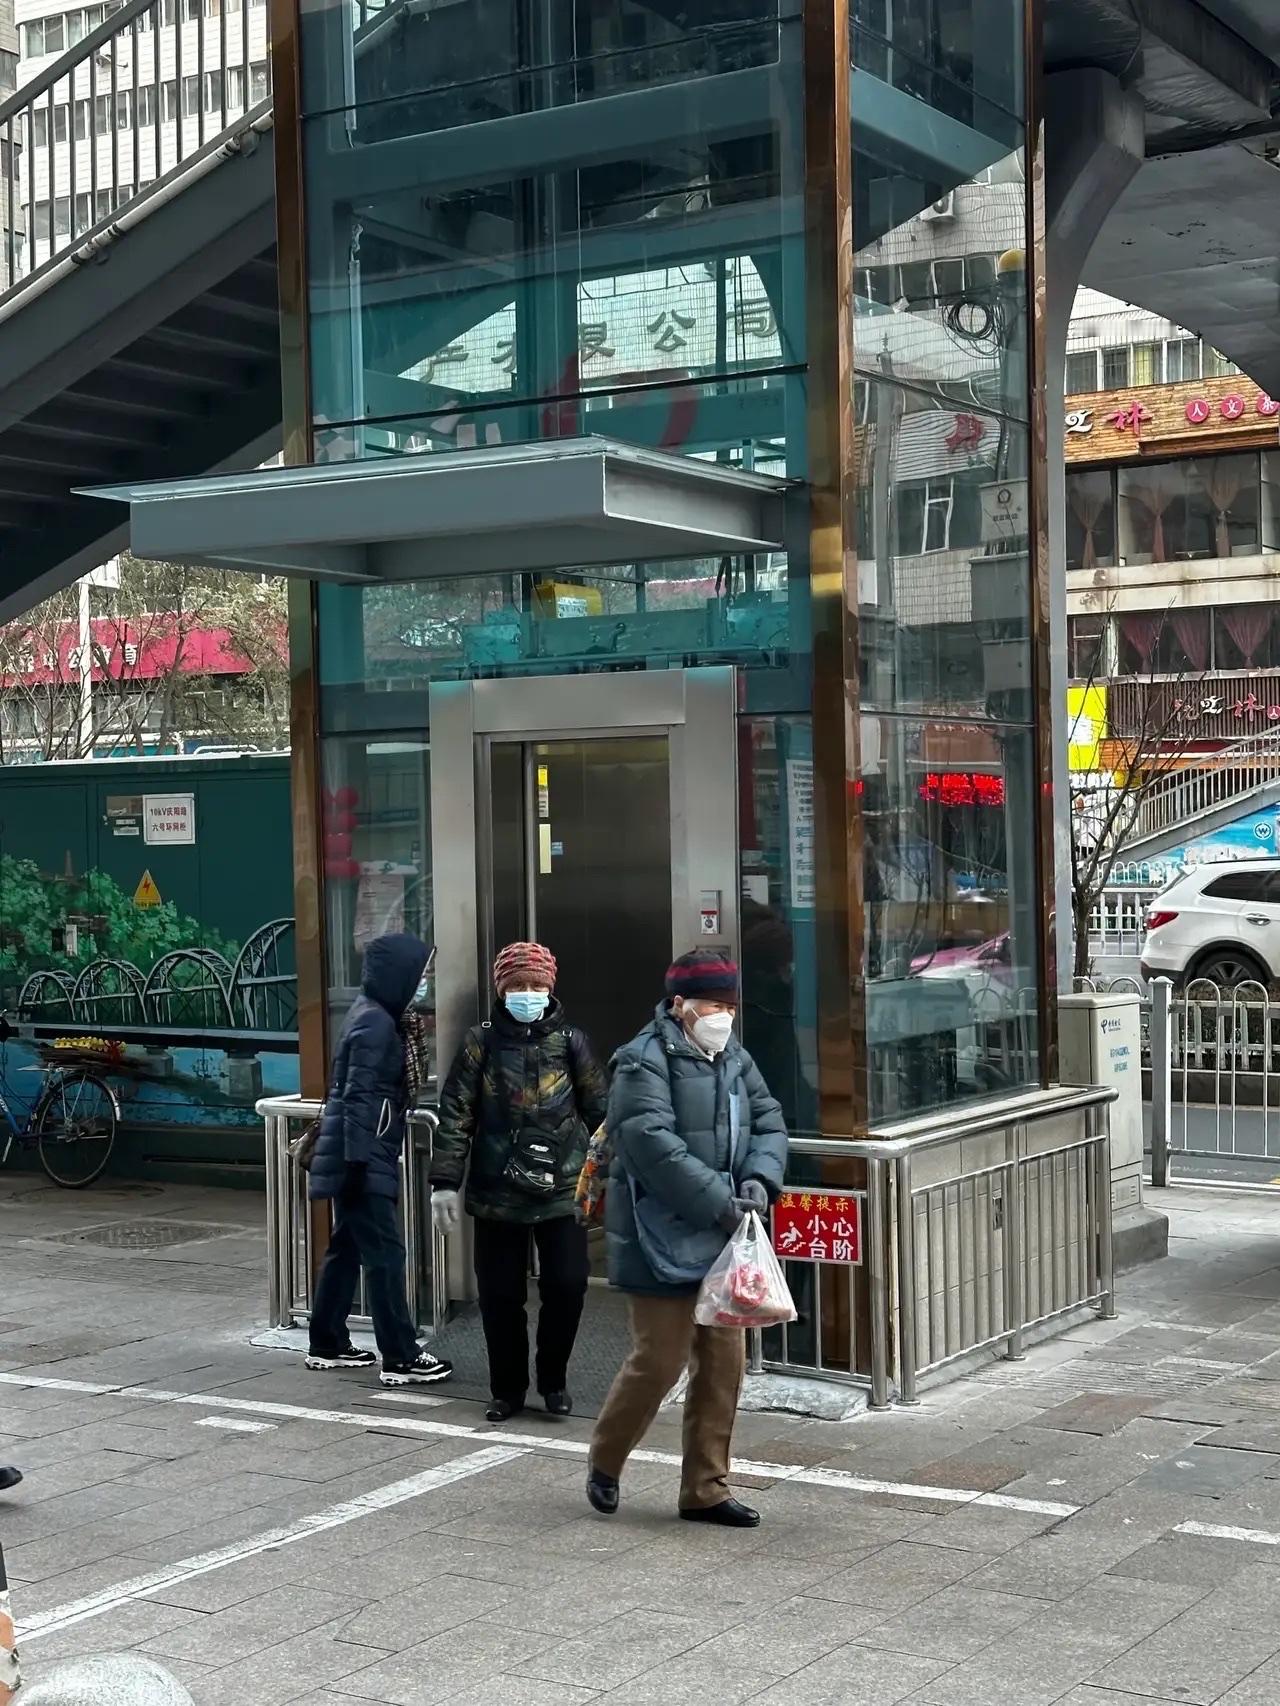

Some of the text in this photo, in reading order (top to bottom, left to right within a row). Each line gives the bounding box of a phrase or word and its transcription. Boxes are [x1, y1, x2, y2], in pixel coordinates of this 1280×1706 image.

[781, 1193, 849, 1212] 温馨提示
[806, 1214, 854, 1237] 小心
[808, 1237, 854, 1260] 台阶
